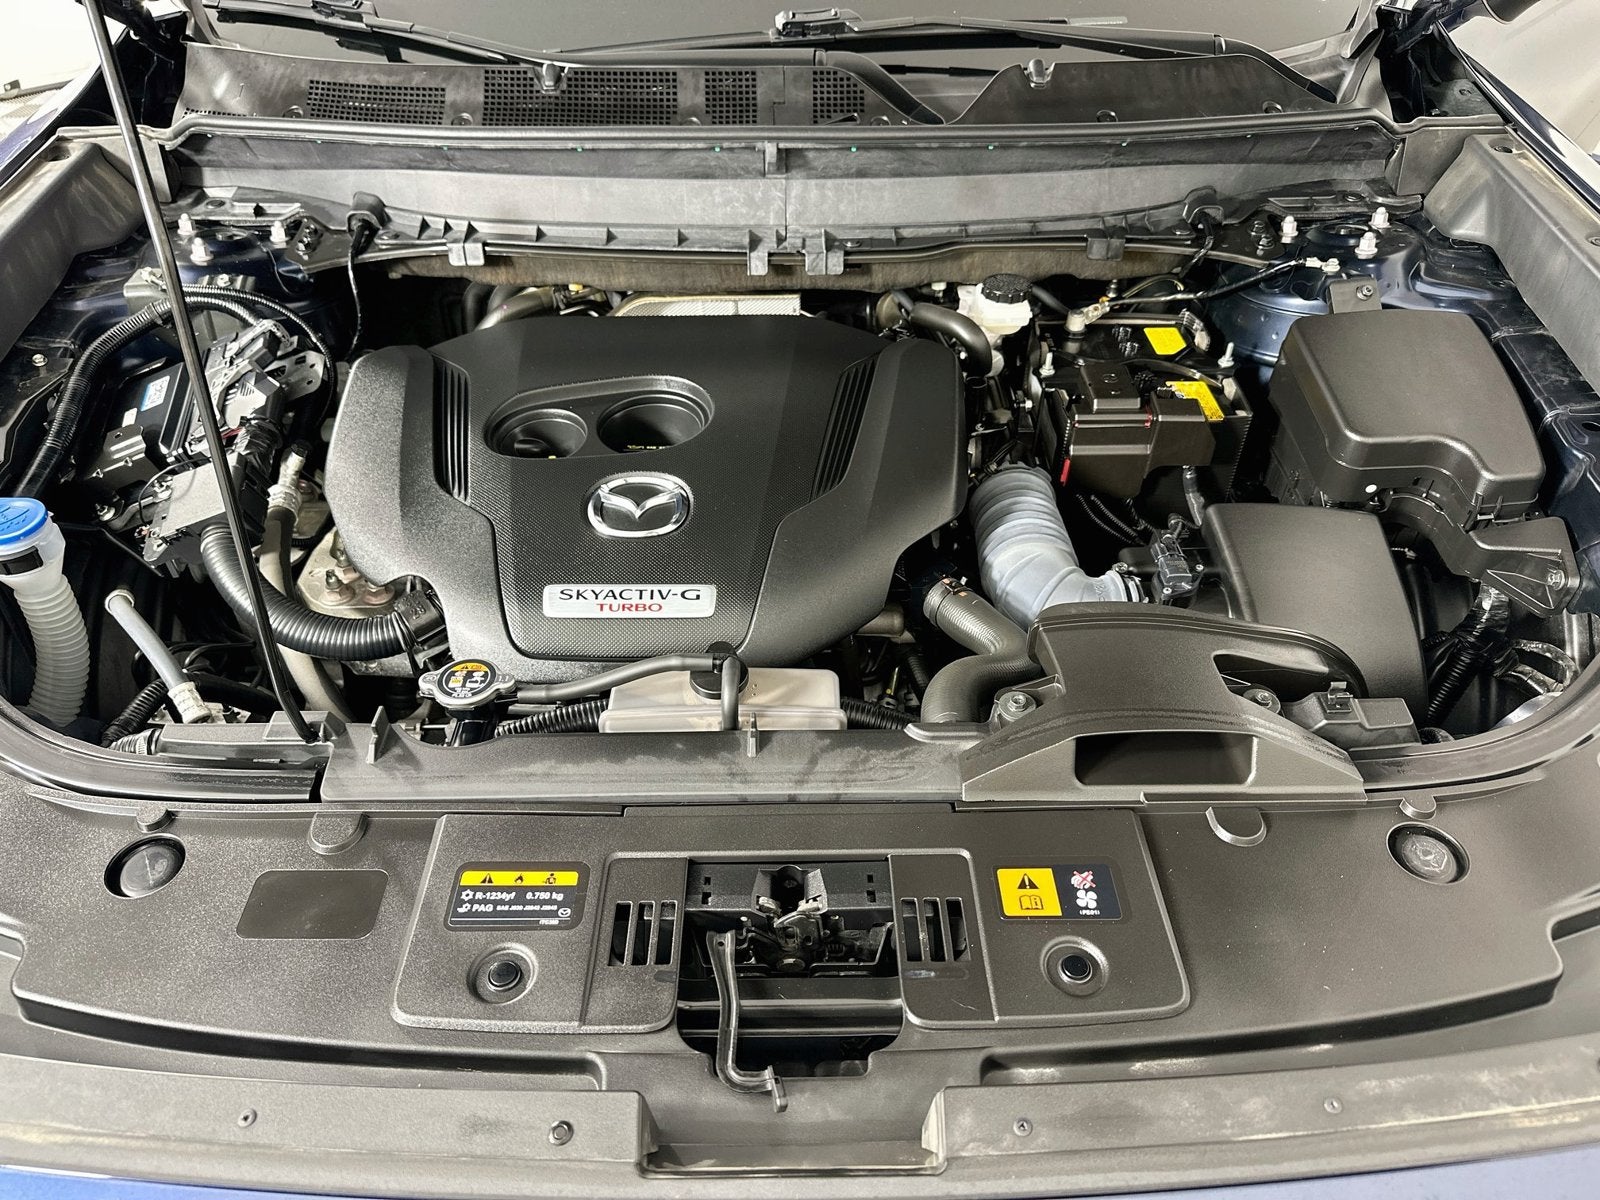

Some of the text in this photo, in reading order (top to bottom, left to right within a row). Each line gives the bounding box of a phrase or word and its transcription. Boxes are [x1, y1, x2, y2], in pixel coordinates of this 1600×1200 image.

[558, 588, 701, 601] SKYACTIV-G
[596, 603, 663, 612] TURBO
[475, 891, 564, 901] R-1234yf 0.750 kg
[472, 903, 494, 912] PAG
